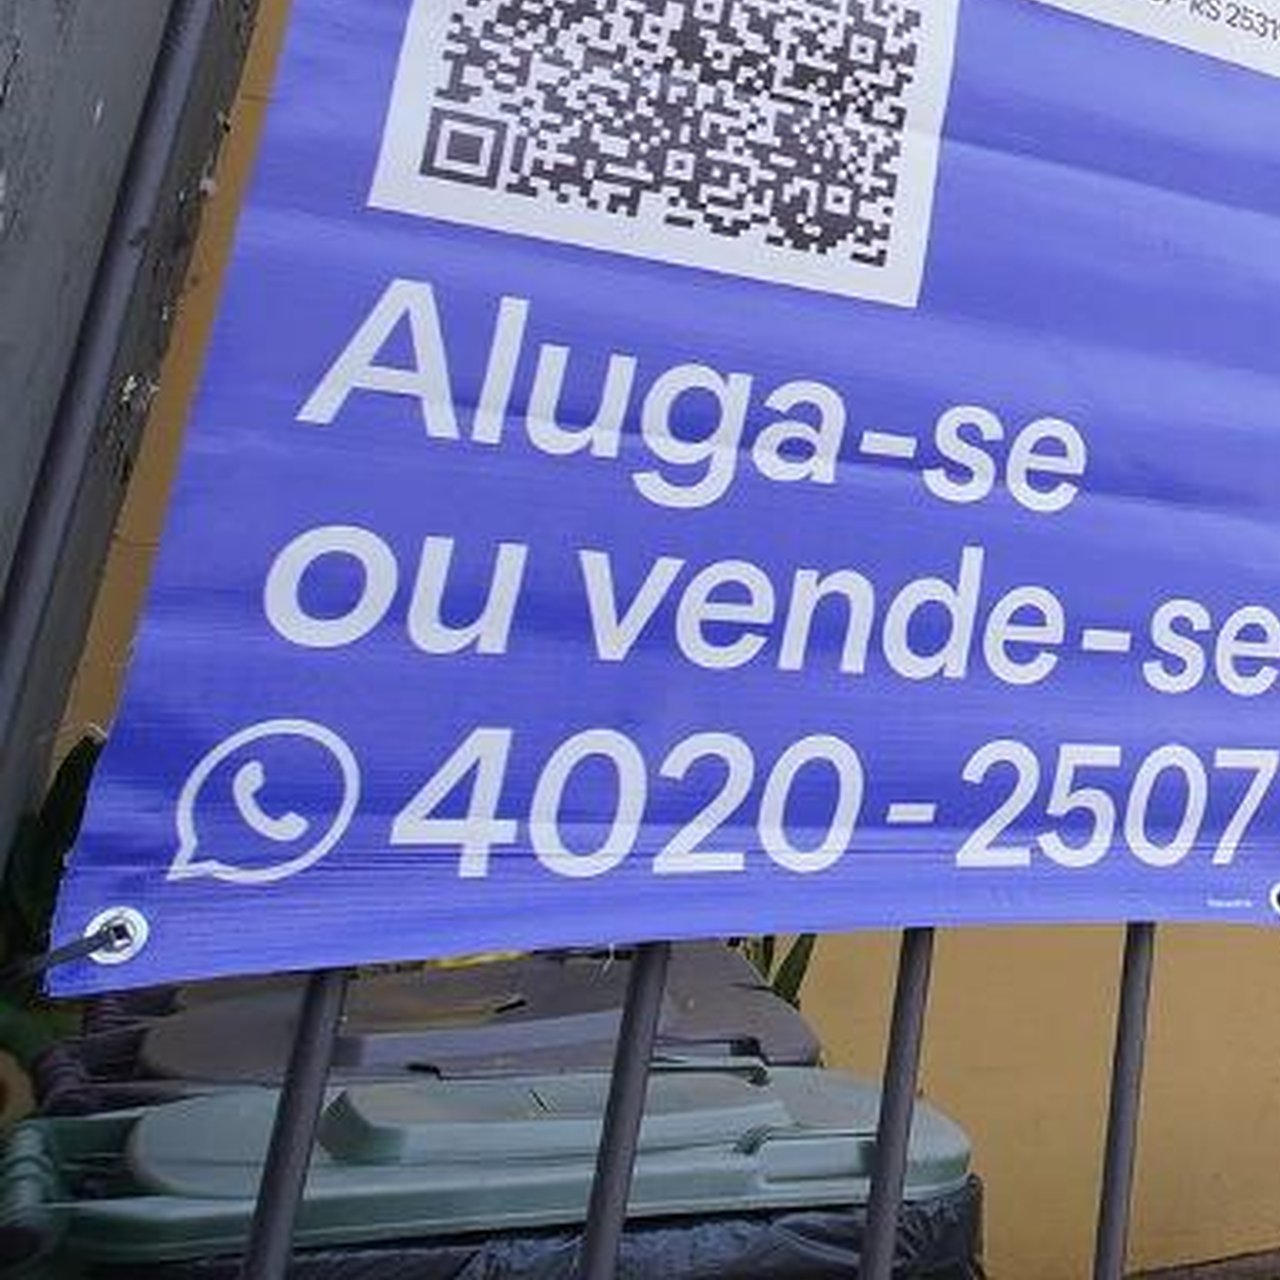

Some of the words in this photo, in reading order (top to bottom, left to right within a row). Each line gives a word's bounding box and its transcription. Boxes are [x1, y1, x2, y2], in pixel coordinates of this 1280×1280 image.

[295, 278, 1087, 513] Aluga-se
[264, 525, 528, 654] ou
[389, 727, 1280, 878] 4020-2507
